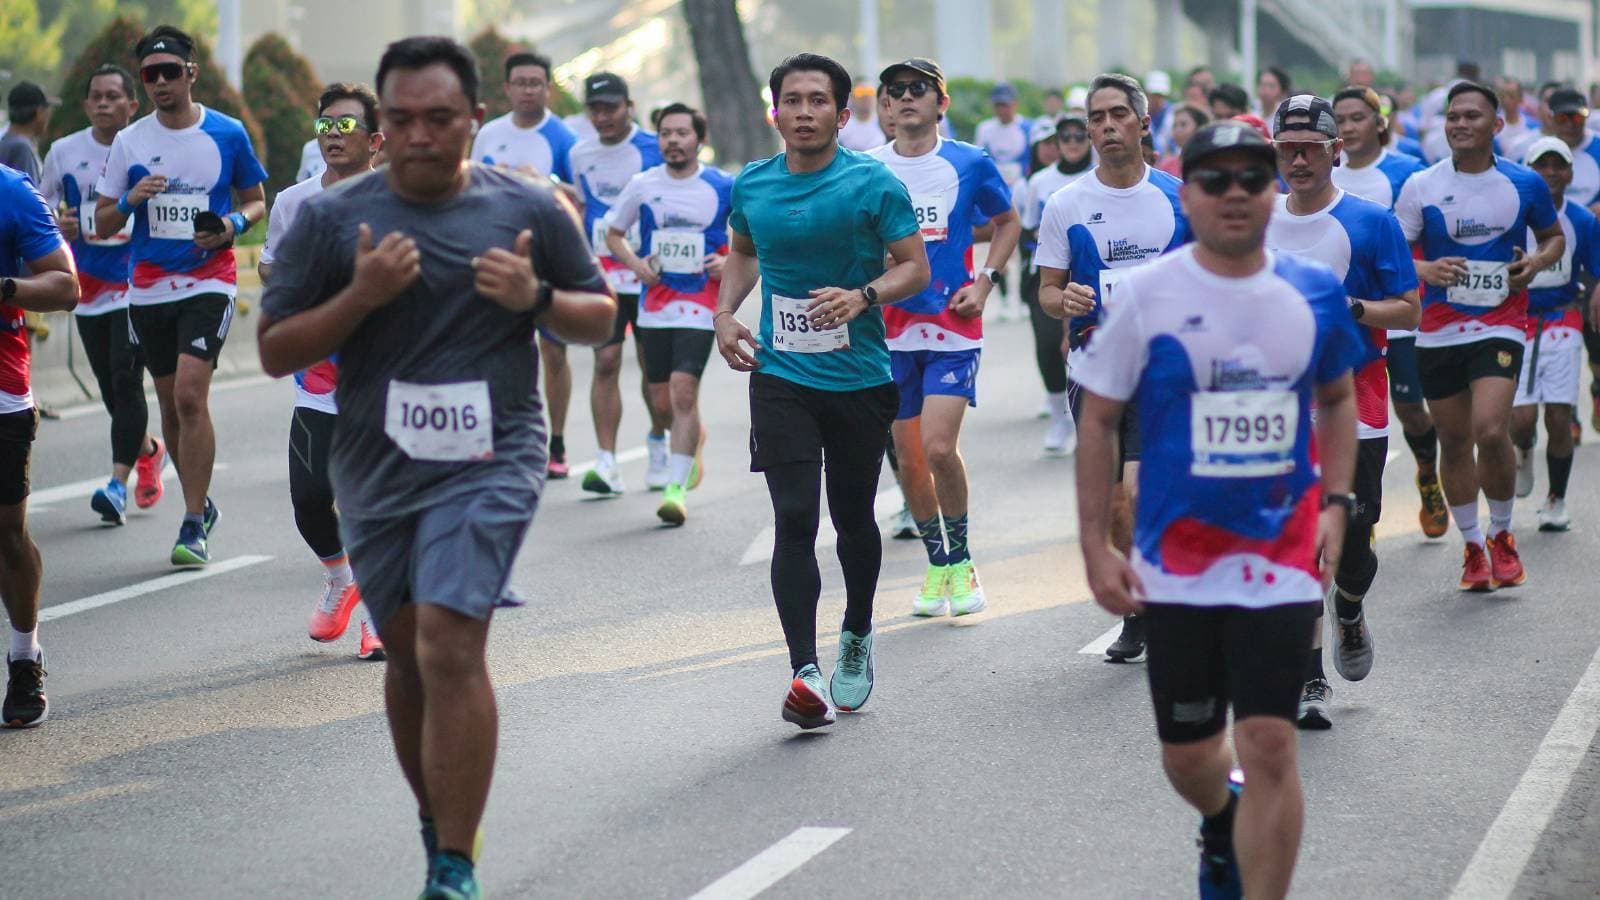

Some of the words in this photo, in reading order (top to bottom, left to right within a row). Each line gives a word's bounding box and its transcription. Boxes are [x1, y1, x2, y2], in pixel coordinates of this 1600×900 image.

[155, 206, 200, 222] 11938
[657, 242, 696, 258] 16741
[1455, 274, 1503, 290] 4753
[775, 335, 784, 344] M
[402, 403, 478, 432] 10016
[1205, 414, 1286, 443] 17993
